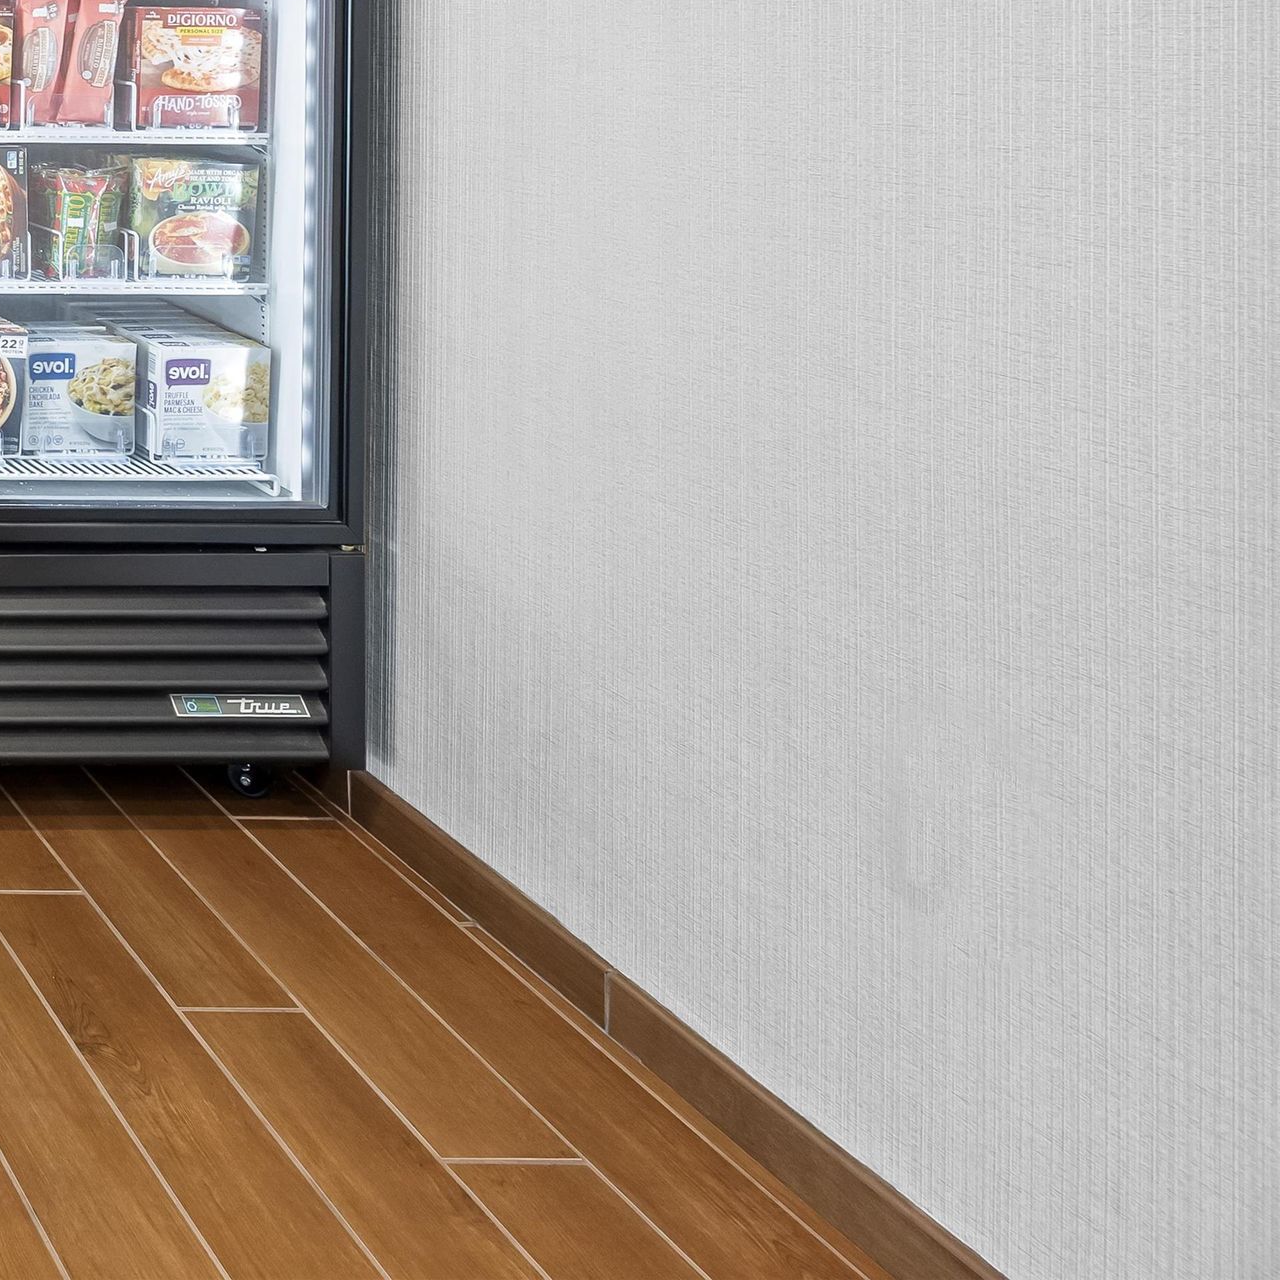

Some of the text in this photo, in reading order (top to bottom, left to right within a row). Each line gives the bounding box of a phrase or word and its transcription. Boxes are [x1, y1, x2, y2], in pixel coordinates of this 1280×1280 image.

[168, 14, 237, 26] DIGIORNO
[93, 38, 105, 68] BURRITO
[156, 93, 240, 113] HAND-TOSSED
[147, 166, 185, 189] Amy's
[64, 195, 85, 260] BURRTO
[0, 340, 17, 348] 22
[227, 698, 301, 713] true
